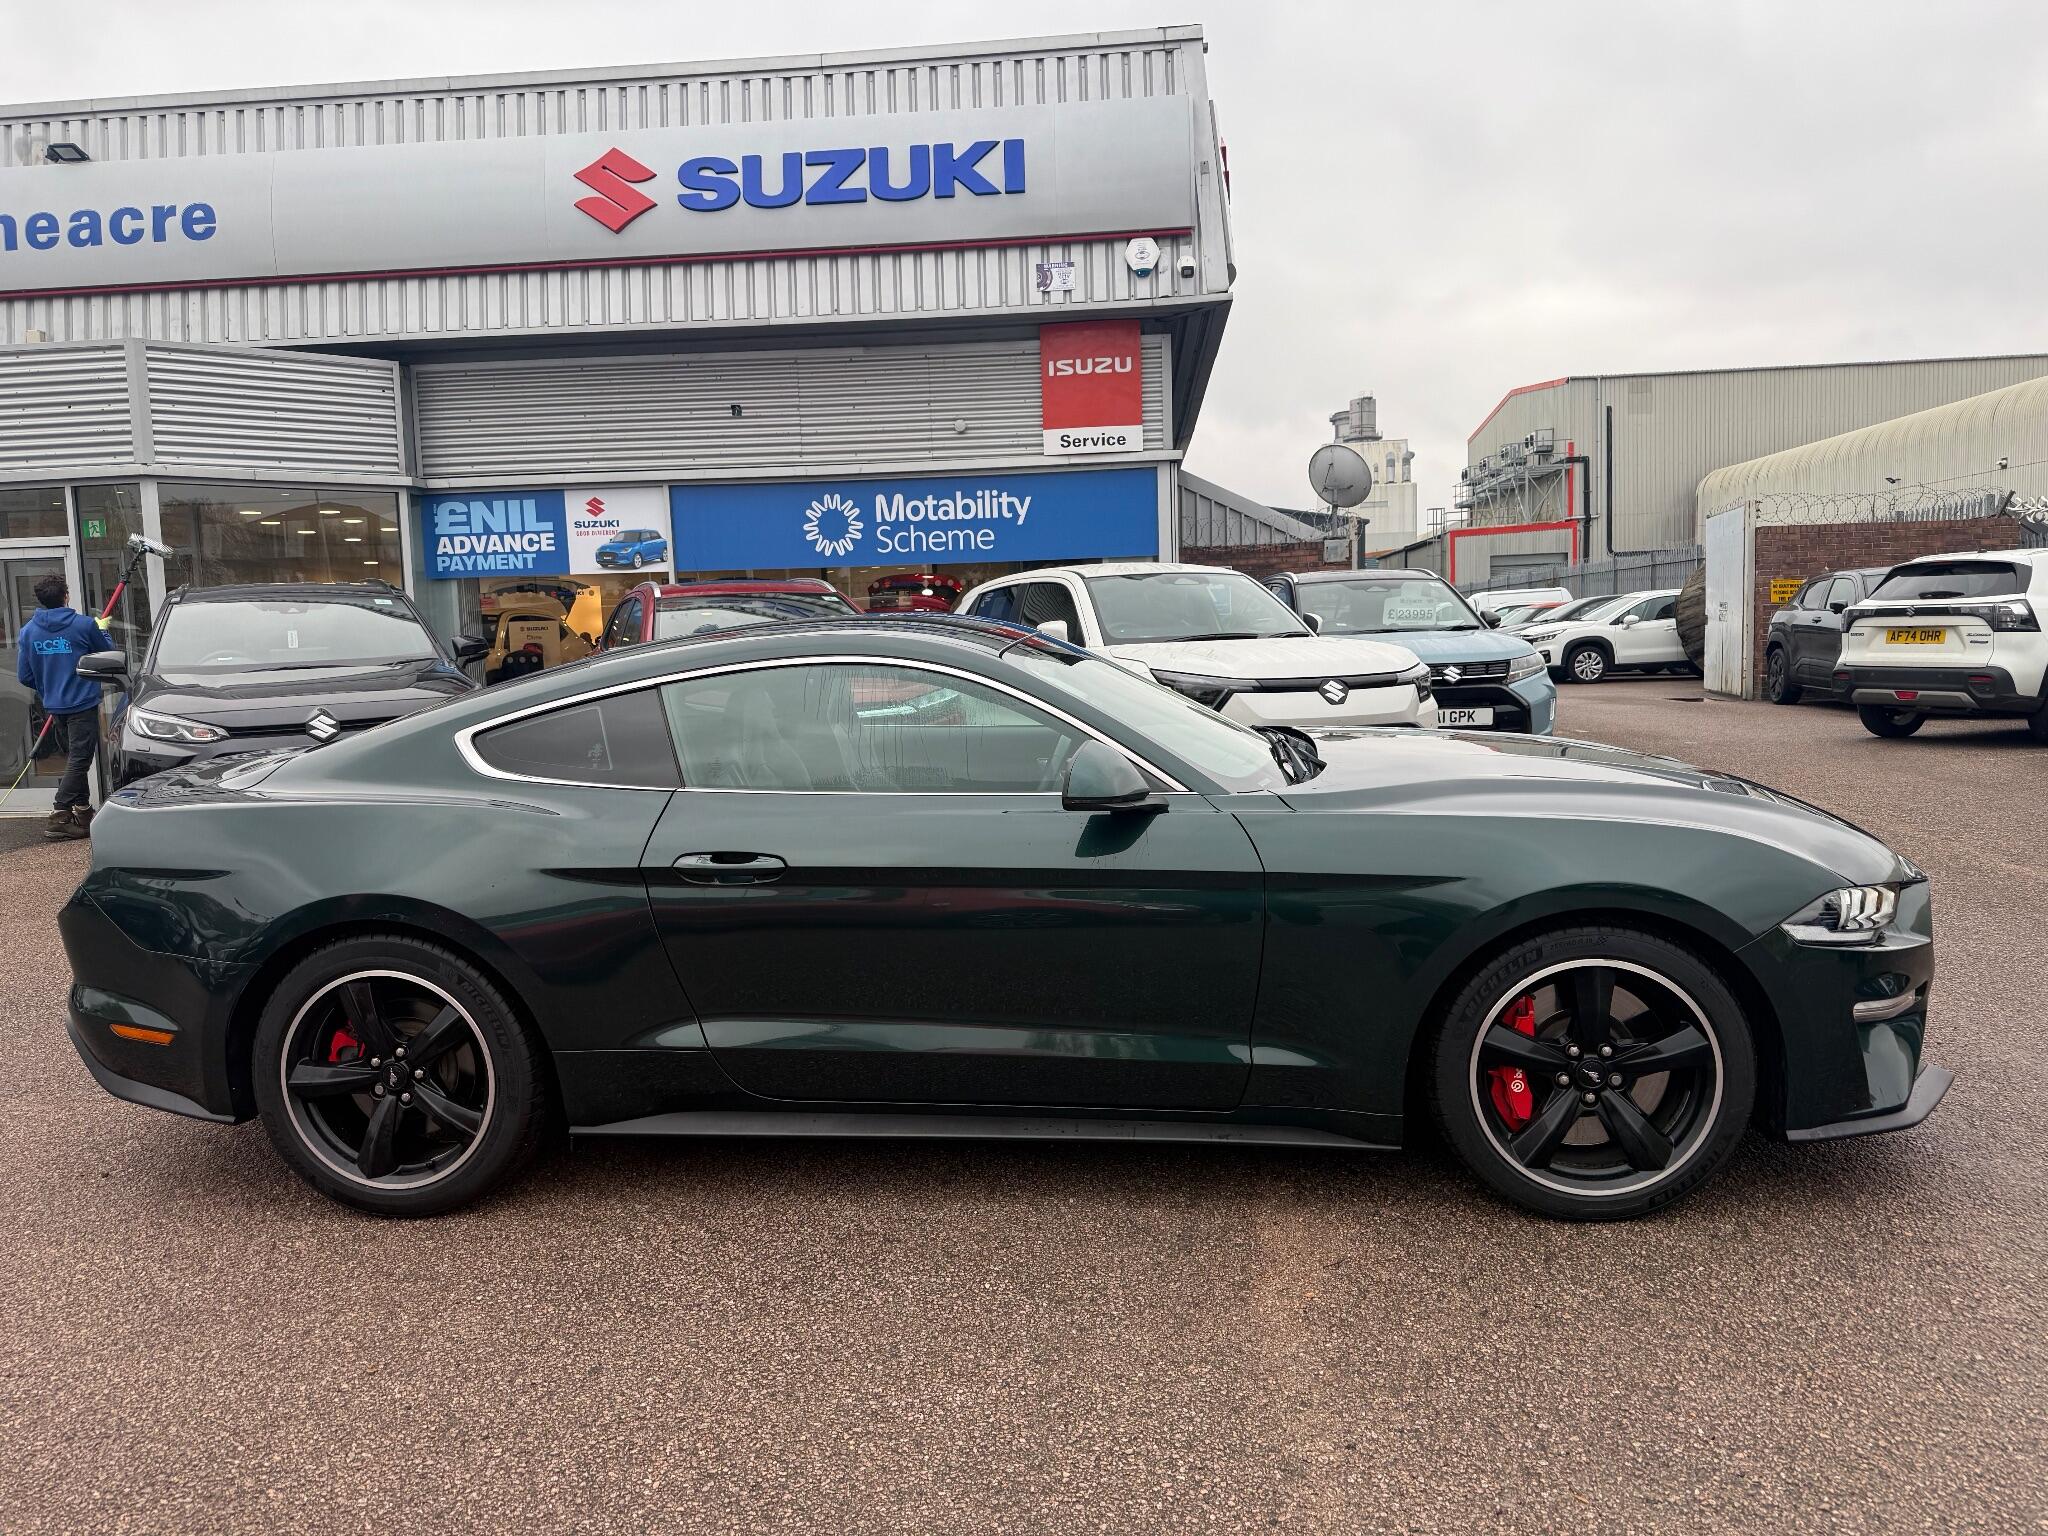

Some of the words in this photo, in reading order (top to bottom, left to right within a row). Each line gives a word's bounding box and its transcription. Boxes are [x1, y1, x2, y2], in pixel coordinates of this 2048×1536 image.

[677, 138, 1026, 212] SUZUKI
[1048, 356, 1132, 377] ISUZU
[1060, 432, 1127, 449] Service
[434, 499, 554, 535] £NIL
[875, 489, 1032, 526] Motability
[574, 519, 620, 529] SUZUKI
[436, 533, 556, 555] ADVANCE
[876, 524, 995, 554] Scheme
[436, 553, 537, 572] PAYMENT
[1890, 630, 1916, 641] AF74
[1449, 710, 1476, 723] GPK
